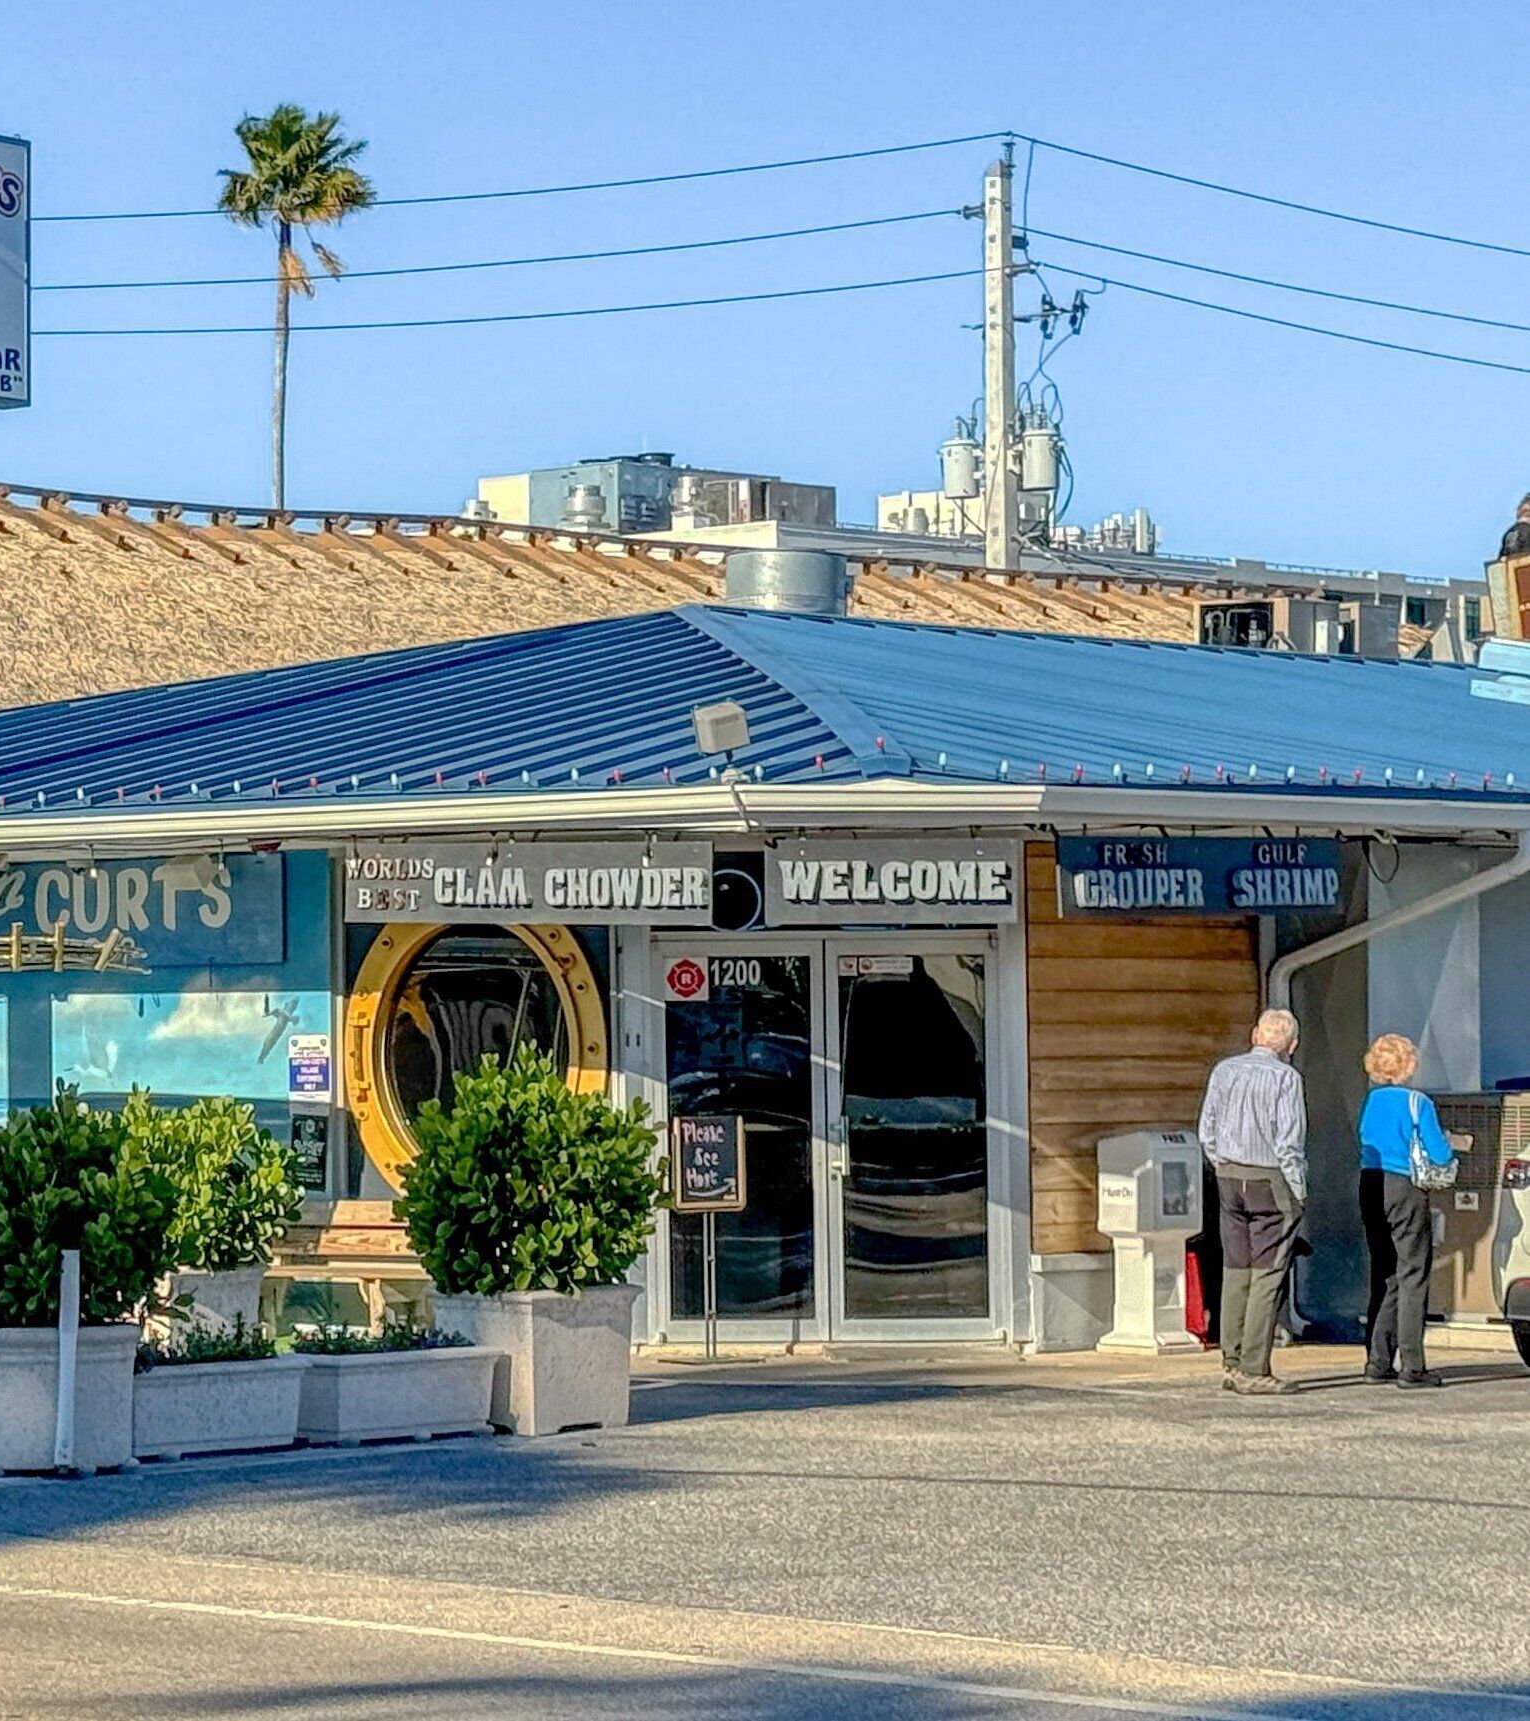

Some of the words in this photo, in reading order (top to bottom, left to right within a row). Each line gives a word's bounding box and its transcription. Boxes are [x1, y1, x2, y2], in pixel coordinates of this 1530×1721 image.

[1258, 844, 1308, 865] GULF
[433, 866, 532, 909] CLAM
[544, 866, 710, 911] CHOWDER
[778, 860, 1013, 905] WELCOME
[1073, 868, 1205, 909] GROUPER
[1232, 868, 1340, 907] SHRIMP
[357, 888, 421, 913] BEST
[681, 973, 692, 985] R
[710, 959, 761, 986] 1200
[681, 1121, 725, 1144] Please
[694, 1147, 720, 1167] See
